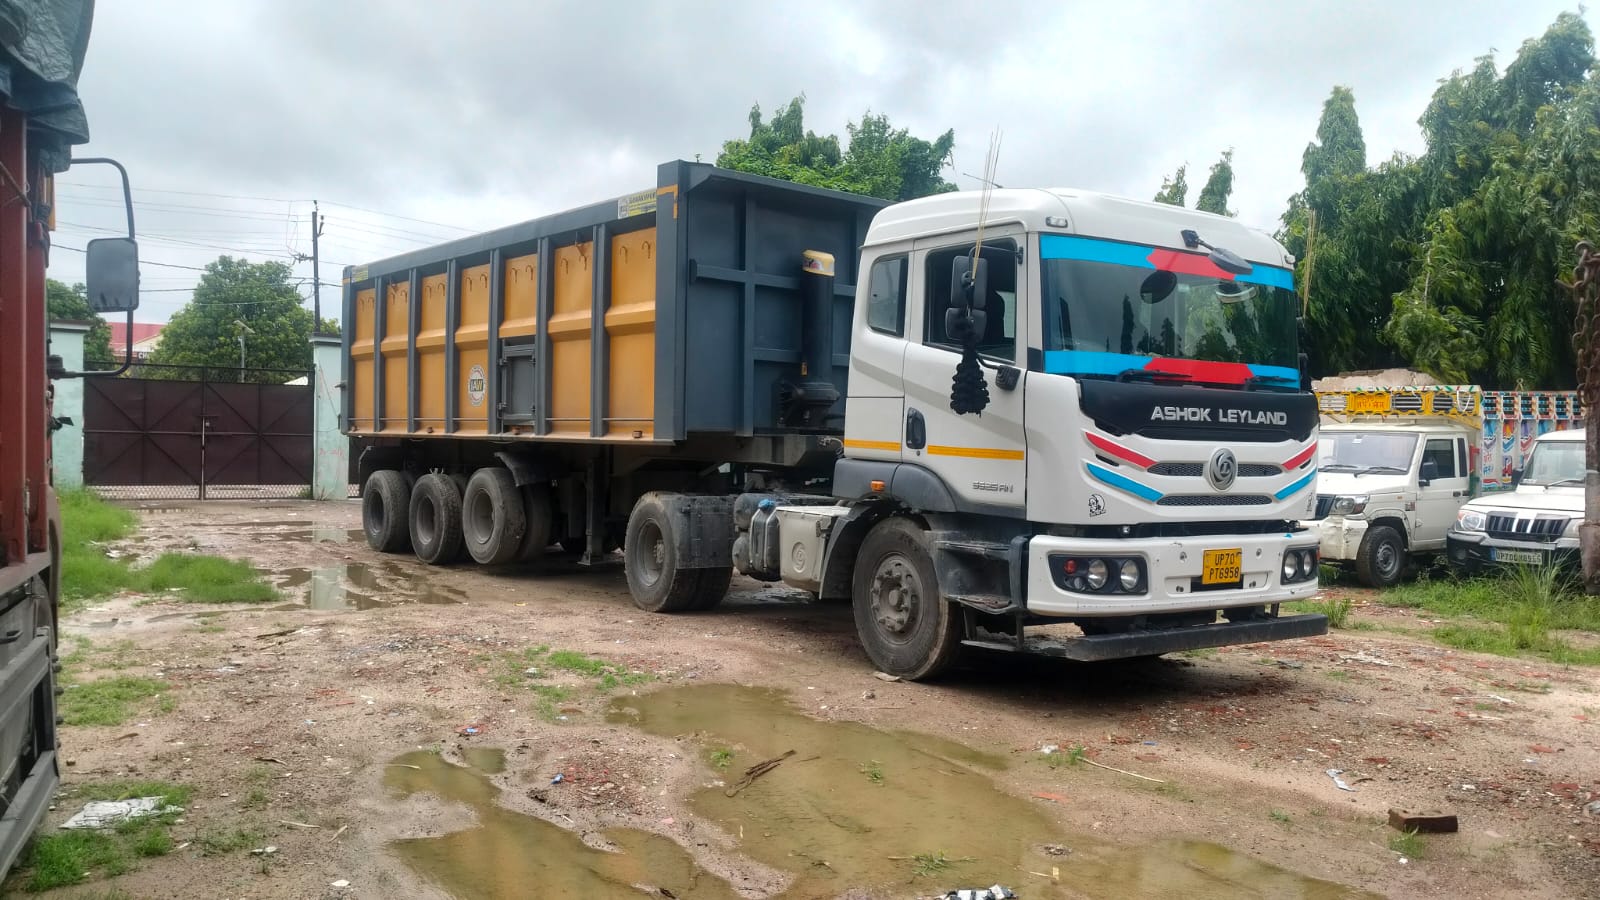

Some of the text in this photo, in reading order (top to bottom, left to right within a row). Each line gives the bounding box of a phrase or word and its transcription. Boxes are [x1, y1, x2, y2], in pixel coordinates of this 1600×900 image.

[1150, 406, 1287, 425] ASHOK LEYLAND
[1215, 553, 1234, 566] UP70
[1209, 566, 1240, 580] PT6958
